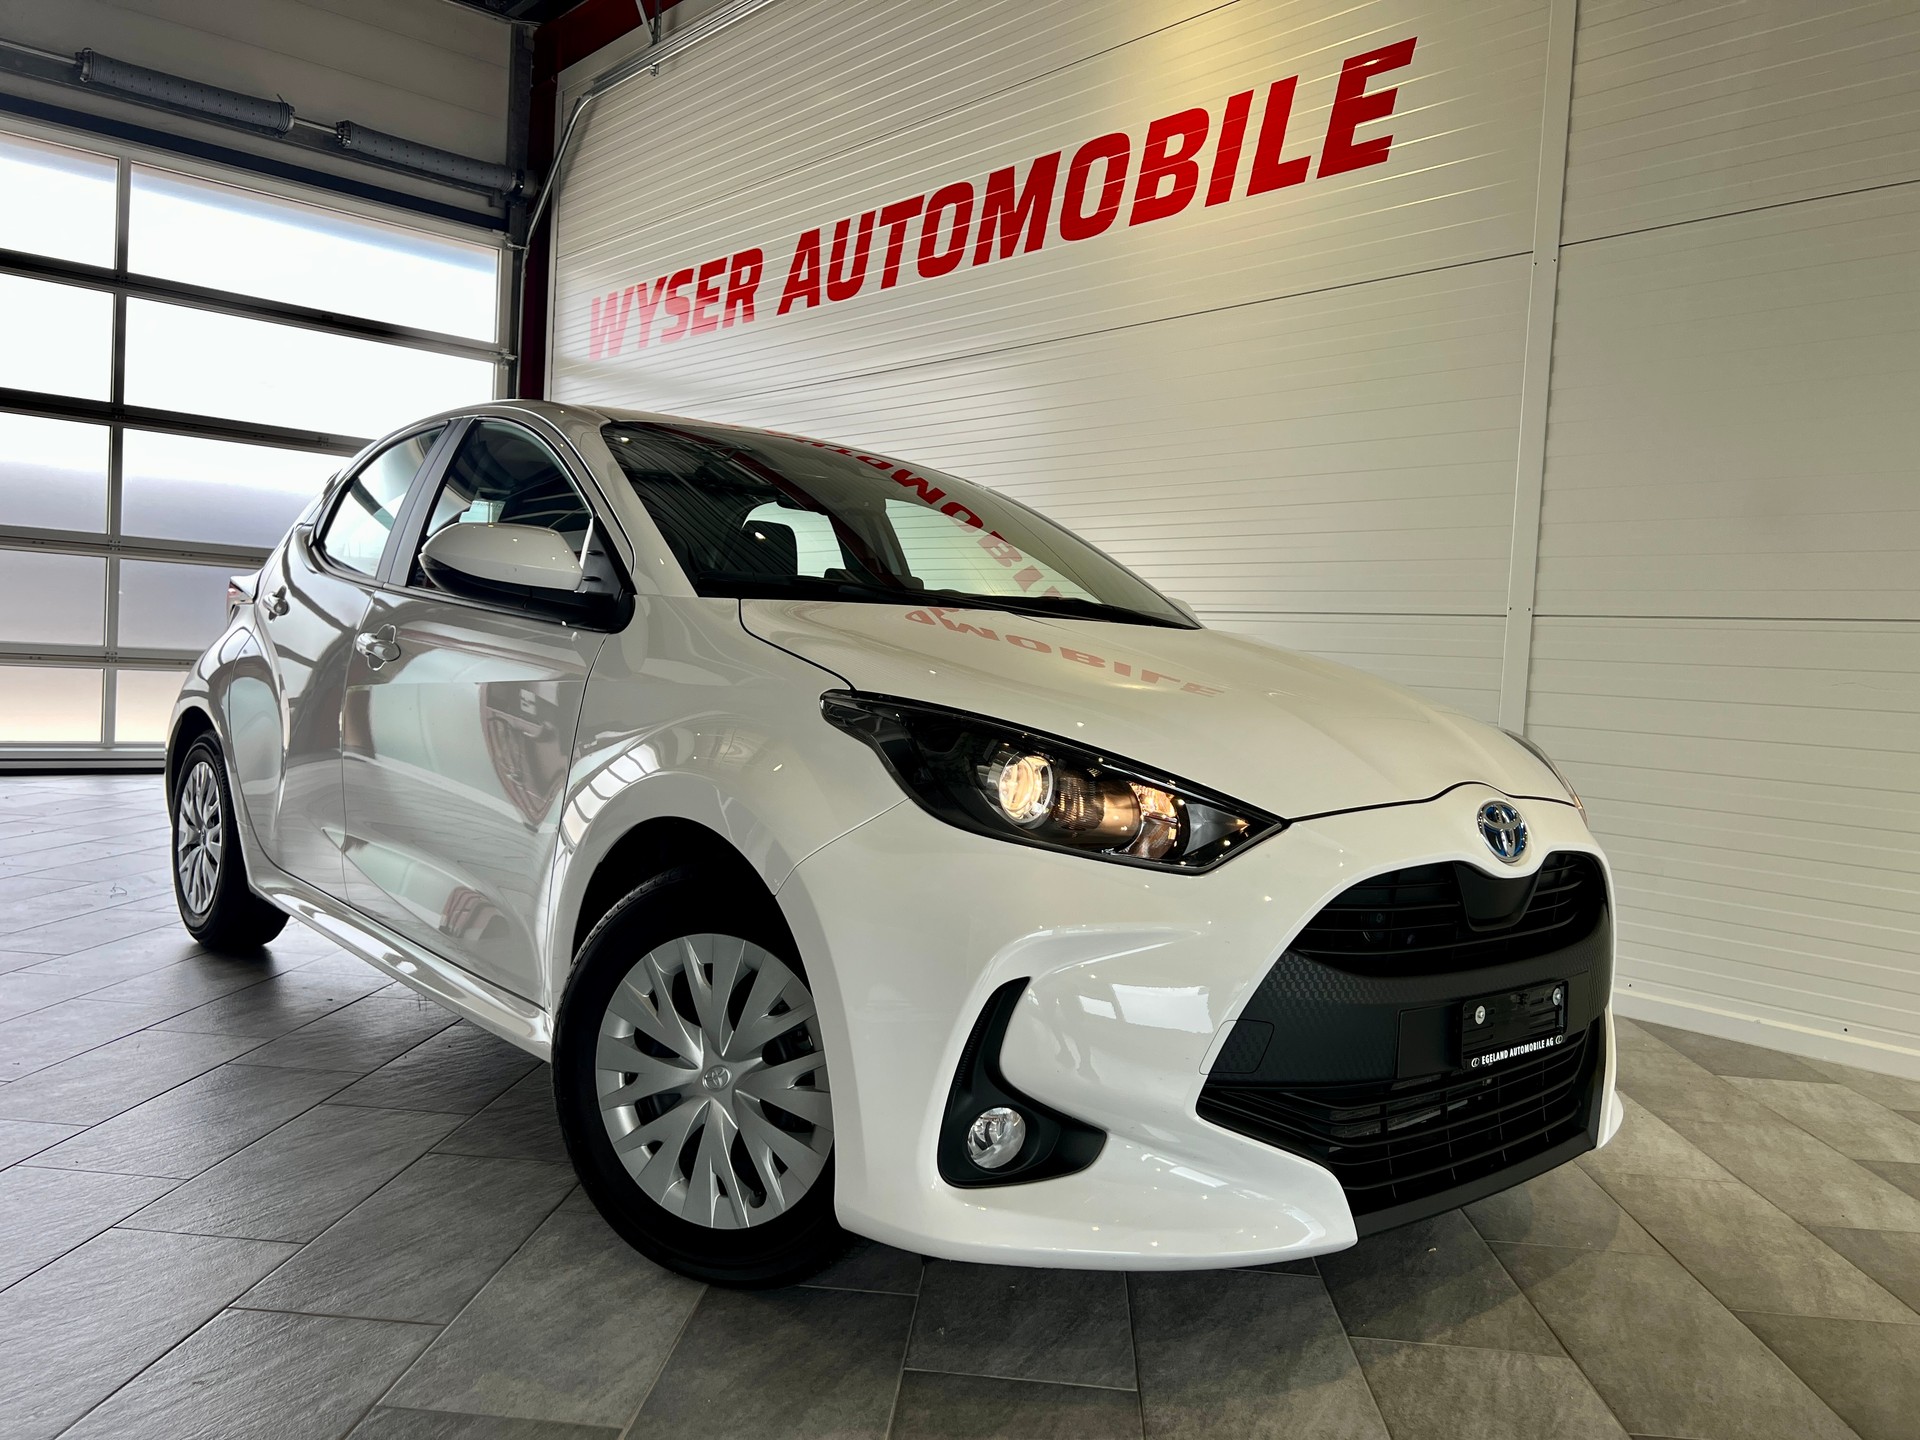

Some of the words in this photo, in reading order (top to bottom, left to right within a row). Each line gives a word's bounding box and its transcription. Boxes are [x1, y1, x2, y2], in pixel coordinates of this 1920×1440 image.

[589, 247, 764, 361] WYSER
[776, 36, 1418, 316] AUTOMOBILE
[1509, 1039, 1545, 1058] AUTOMOBILE
[1545, 1037, 1554, 1048] AG
